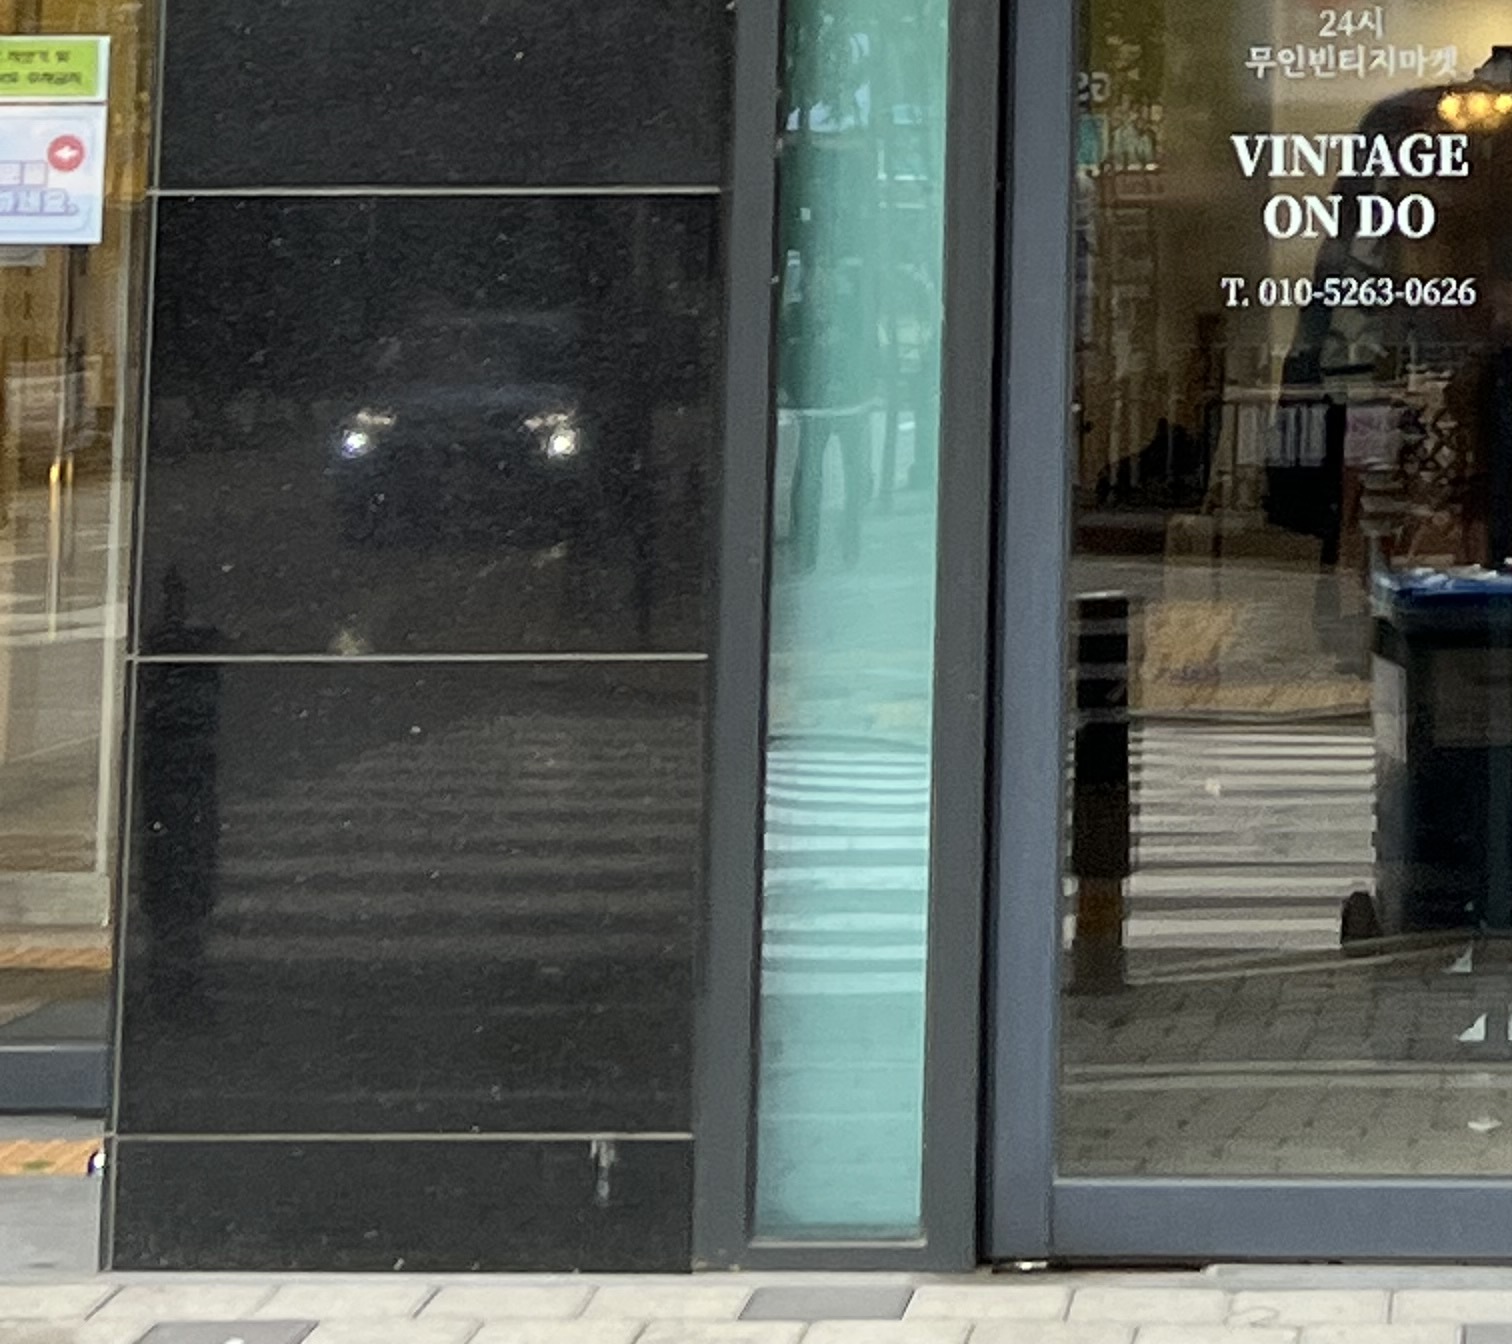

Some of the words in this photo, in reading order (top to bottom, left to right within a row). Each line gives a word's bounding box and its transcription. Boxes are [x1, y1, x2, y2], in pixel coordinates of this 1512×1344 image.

[1318, 6, 1385, 40] 24시
[1230, 133, 1469, 178] VINTAGE
[1263, 193, 1342, 240] ON
[1356, 193, 1436, 240] DO
[1220, 276, 1250, 308] T.
[1258, 276, 1478, 309] 010-5263-0626
